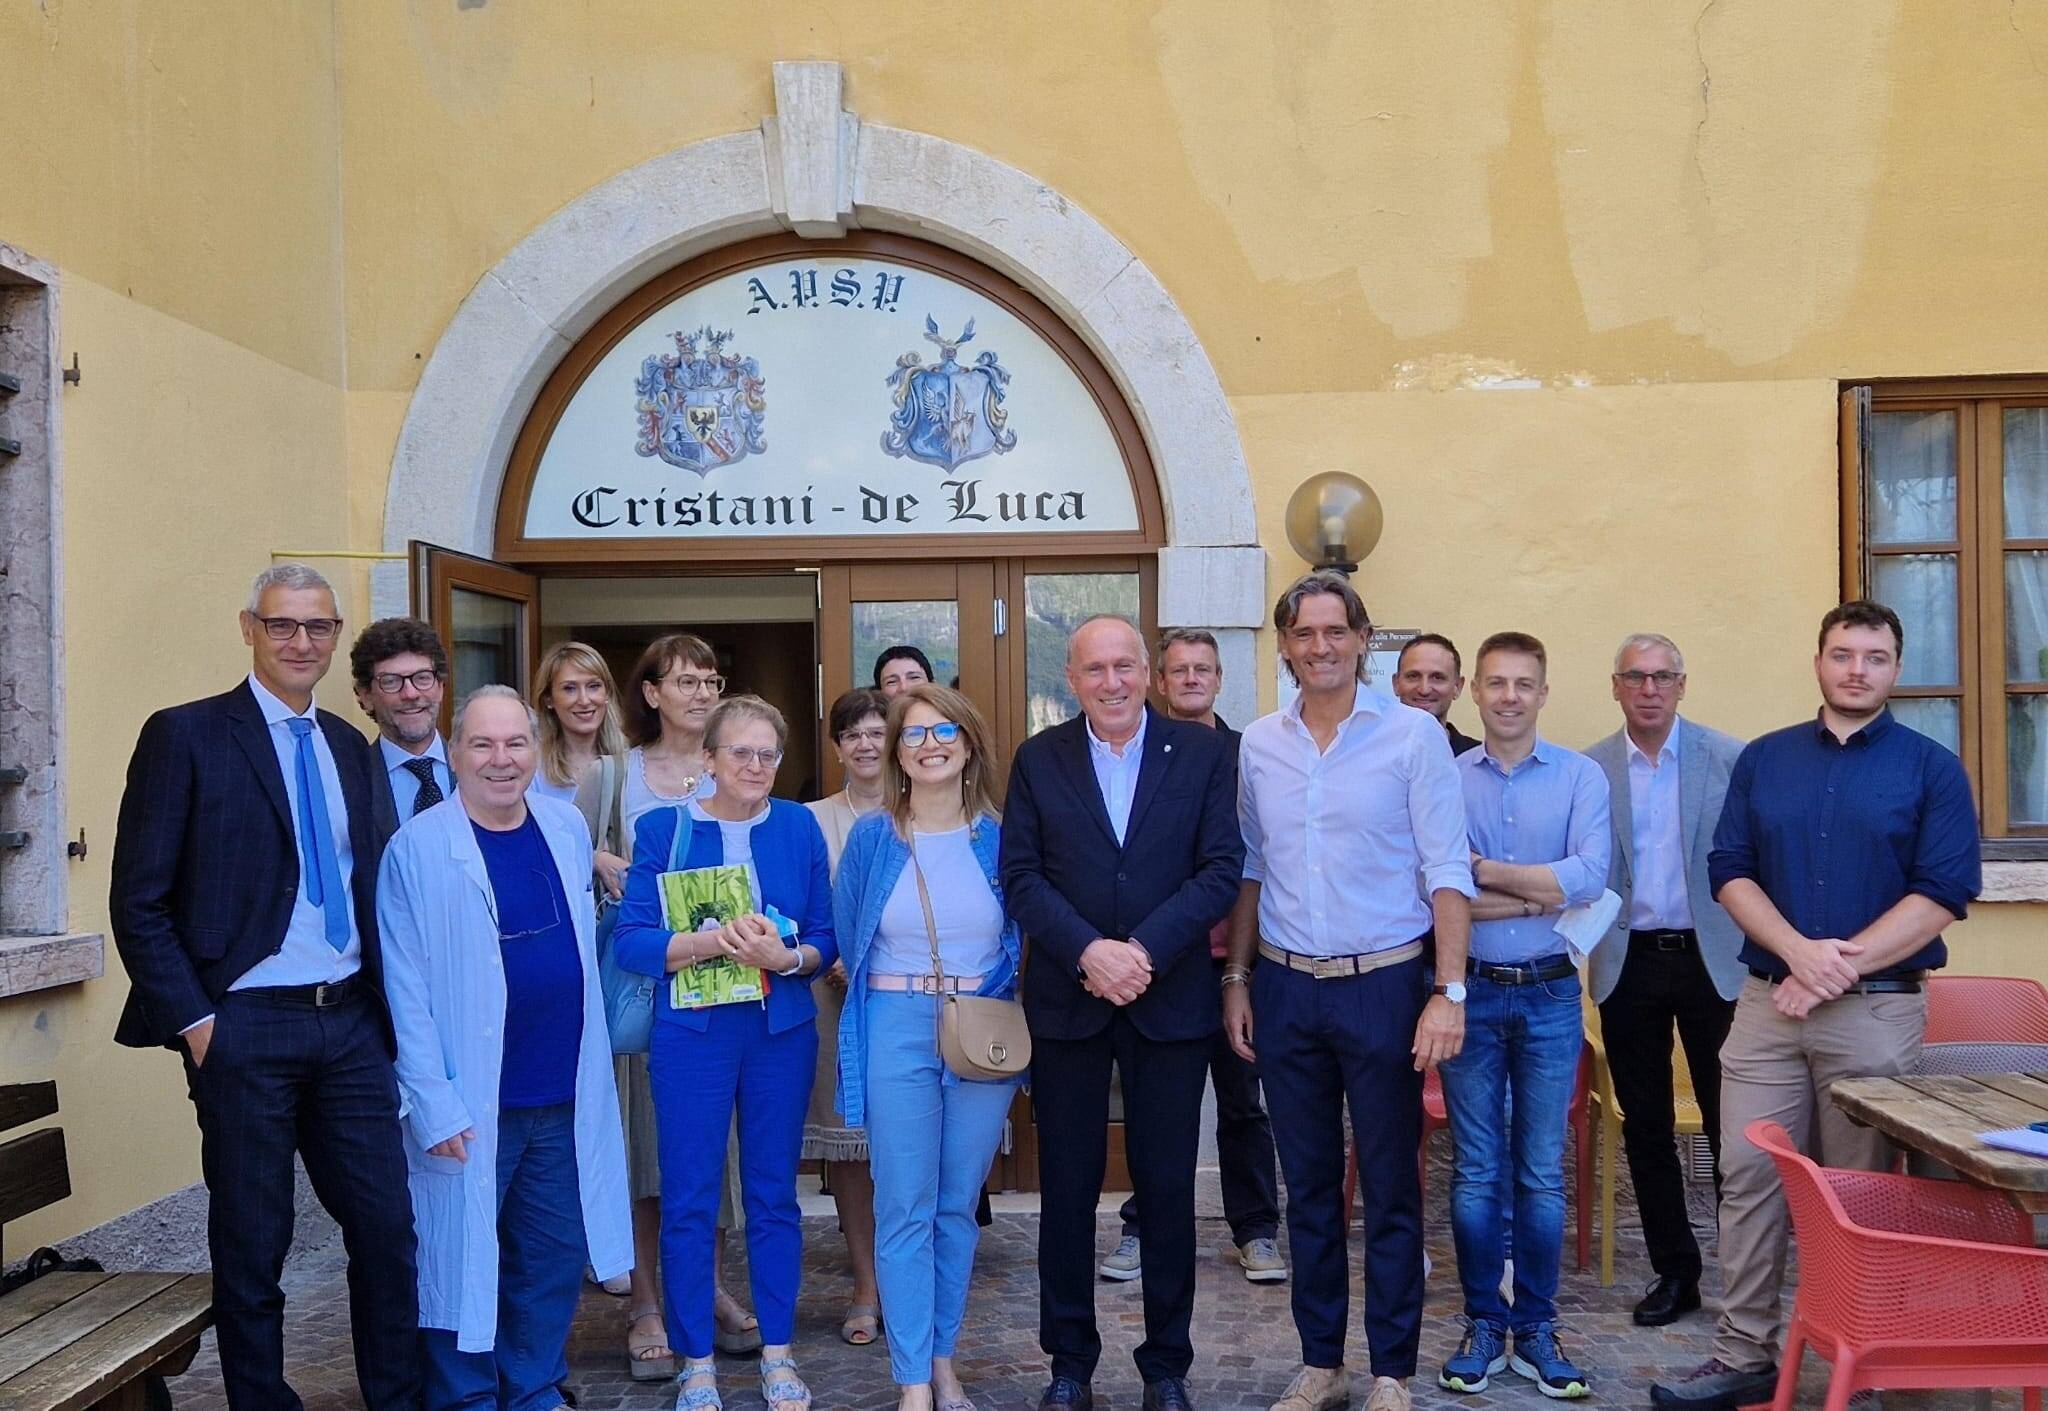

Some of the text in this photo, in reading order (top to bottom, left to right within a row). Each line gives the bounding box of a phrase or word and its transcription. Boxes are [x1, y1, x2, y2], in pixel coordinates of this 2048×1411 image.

[747, 268, 905, 316] A.P.S.P.
[572, 485, 814, 529] Cristani
[859, 485, 920, 525] de
[940, 479, 1086, 524] Luca
